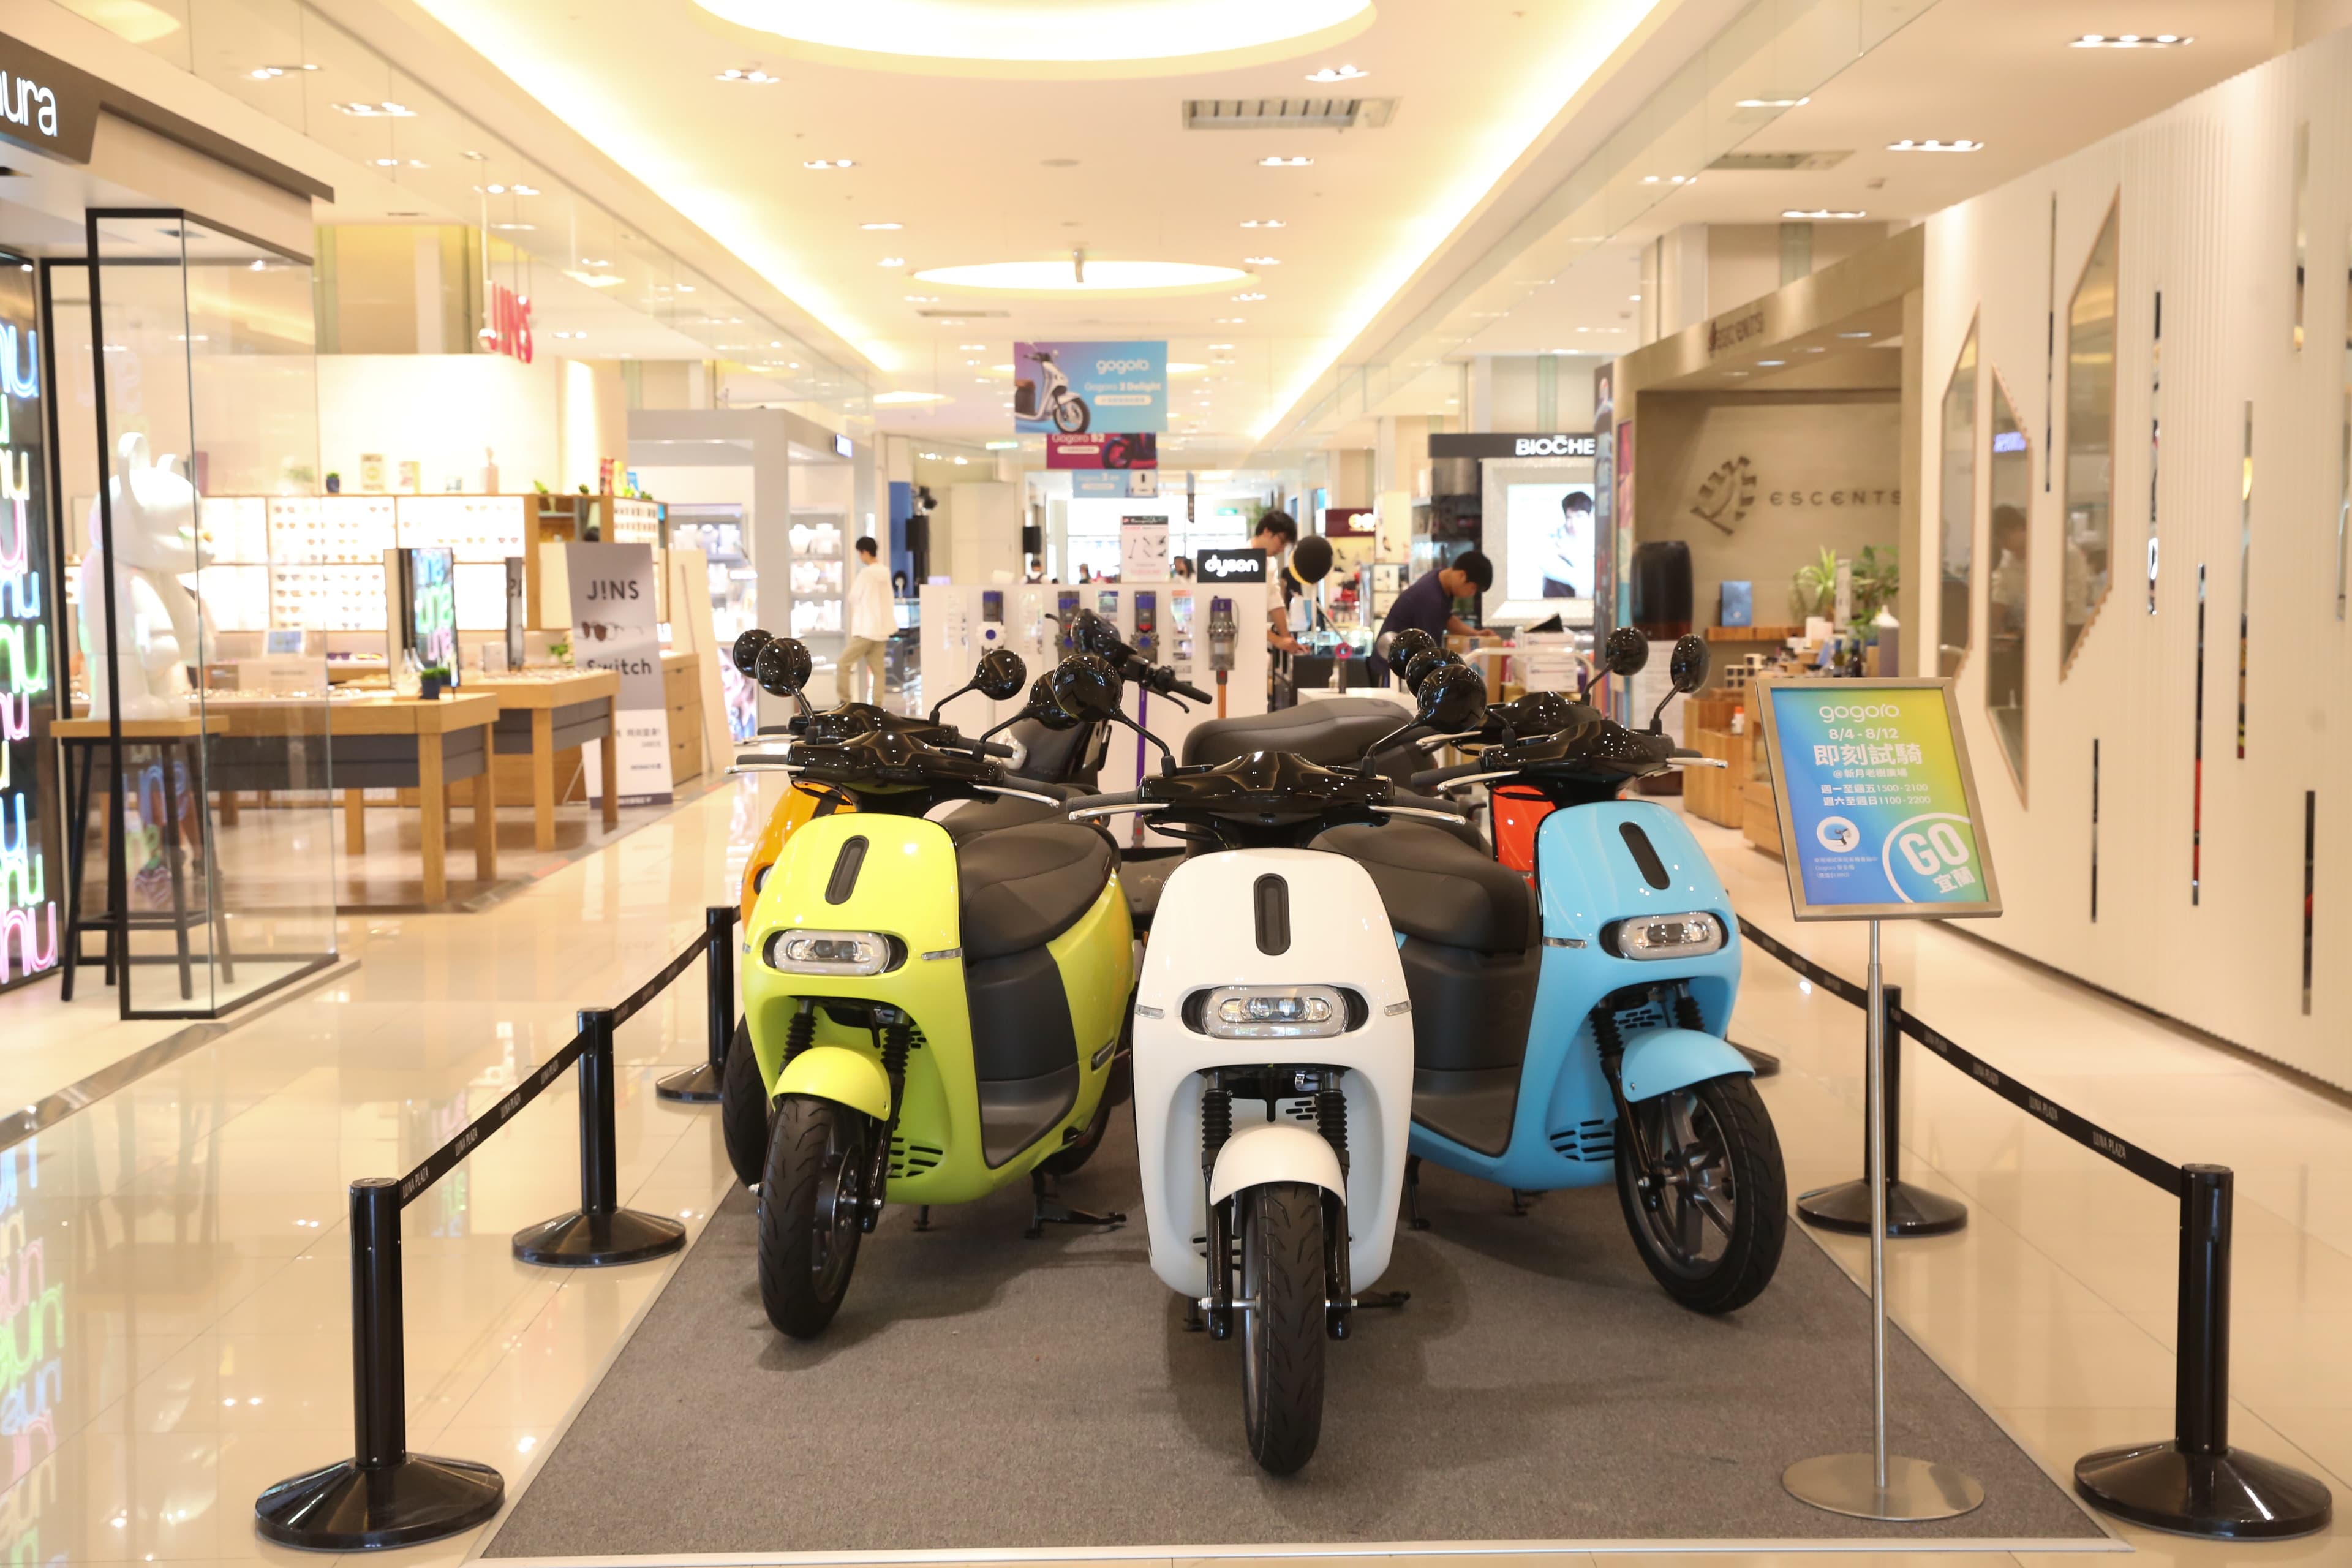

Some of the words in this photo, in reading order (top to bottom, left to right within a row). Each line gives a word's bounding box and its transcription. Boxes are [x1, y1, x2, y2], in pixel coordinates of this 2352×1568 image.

[0, 70, 58, 137] ura
[1205, 554, 1259, 578] dyson
[1819, 703, 1901, 723] gogoro
[1828, 729, 1855, 742] 8/4
[1866, 728, 1899, 741] 8/12
[1814, 743, 1923, 766] 即刻試騎
[1899, 823, 1970, 876] GO
[2092, 1131, 2108, 1149] LUNA
[2108, 1137, 2127, 1160] PLAZA
[402, 1177, 415, 1199] LUNA
[415, 1166, 429, 1189] PLAZA
